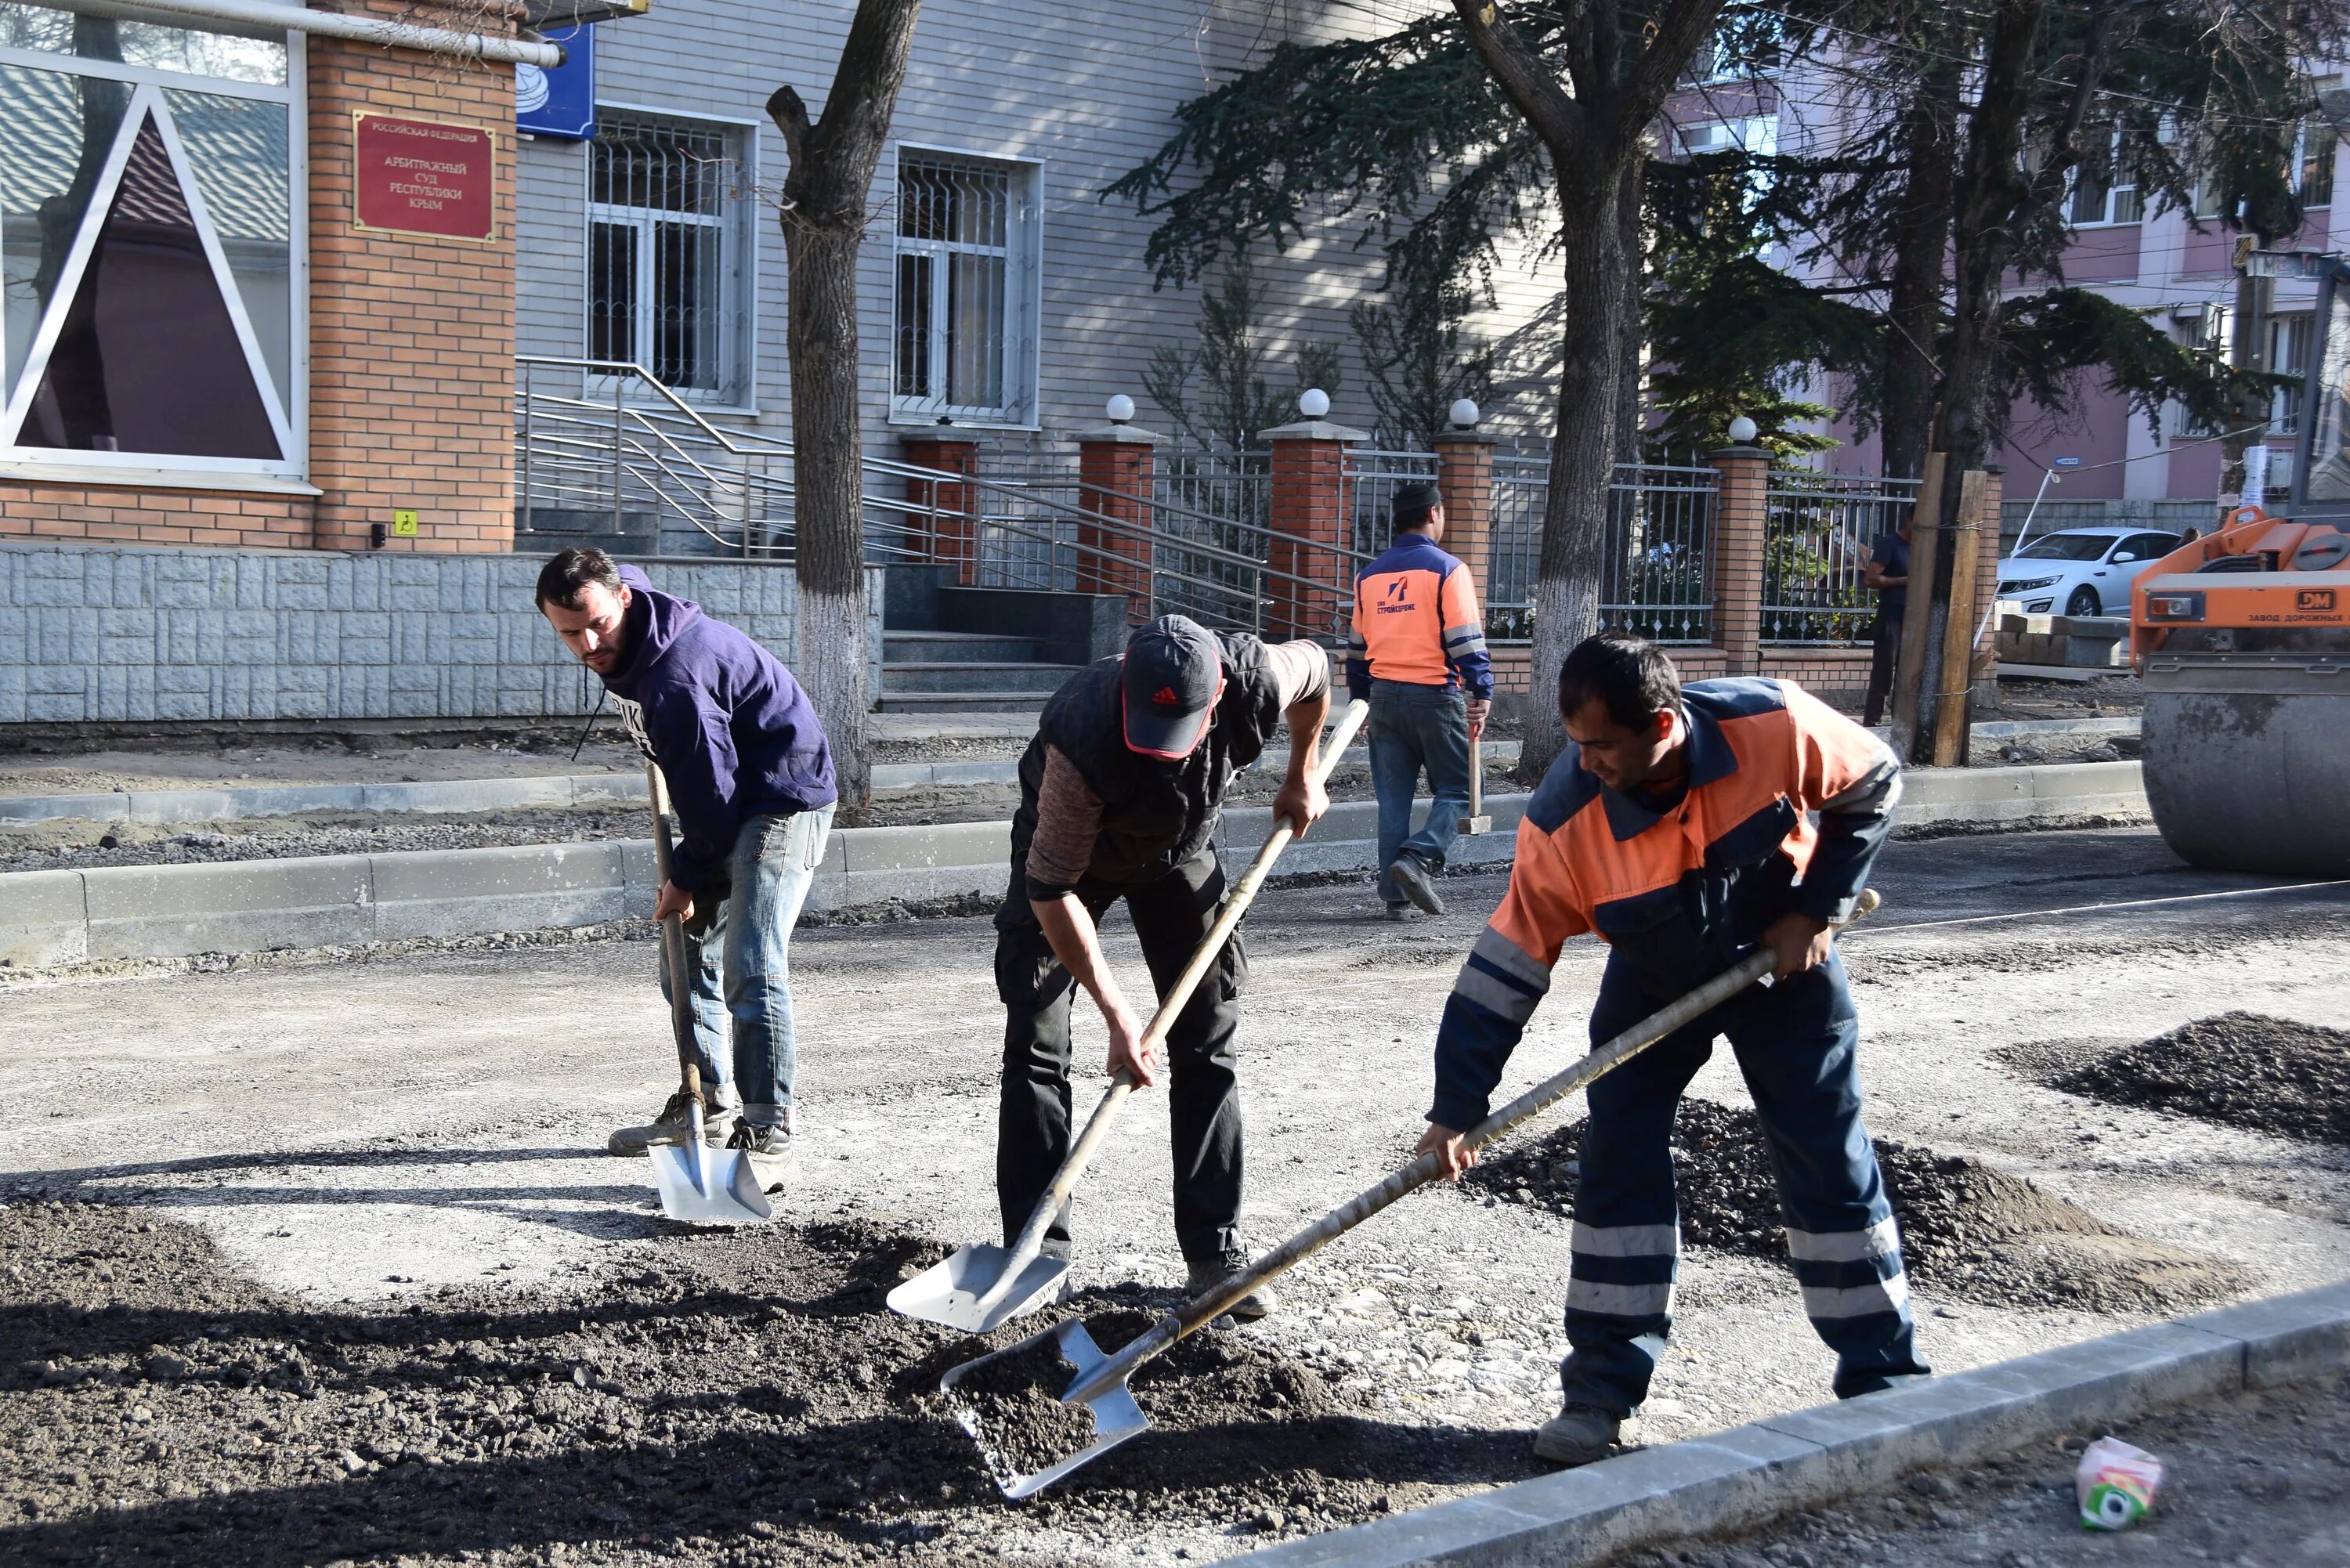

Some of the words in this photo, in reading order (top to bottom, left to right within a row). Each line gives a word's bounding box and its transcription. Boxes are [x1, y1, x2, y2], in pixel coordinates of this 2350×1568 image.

[372, 122, 428, 137] РОССИЙСКАЯ
[429, 129, 478, 143] ФЕДЕРАЦИЯ
[385, 156, 467, 175] АРБИТРАЖНЫЙ
[414, 172, 438, 185] СУД
[389, 182, 462, 200] РЕСПУБЛИКИ
[409, 197, 443, 210] КРЫМ
[1377, 604, 1415, 614] СТРОЙСЕРВИС
